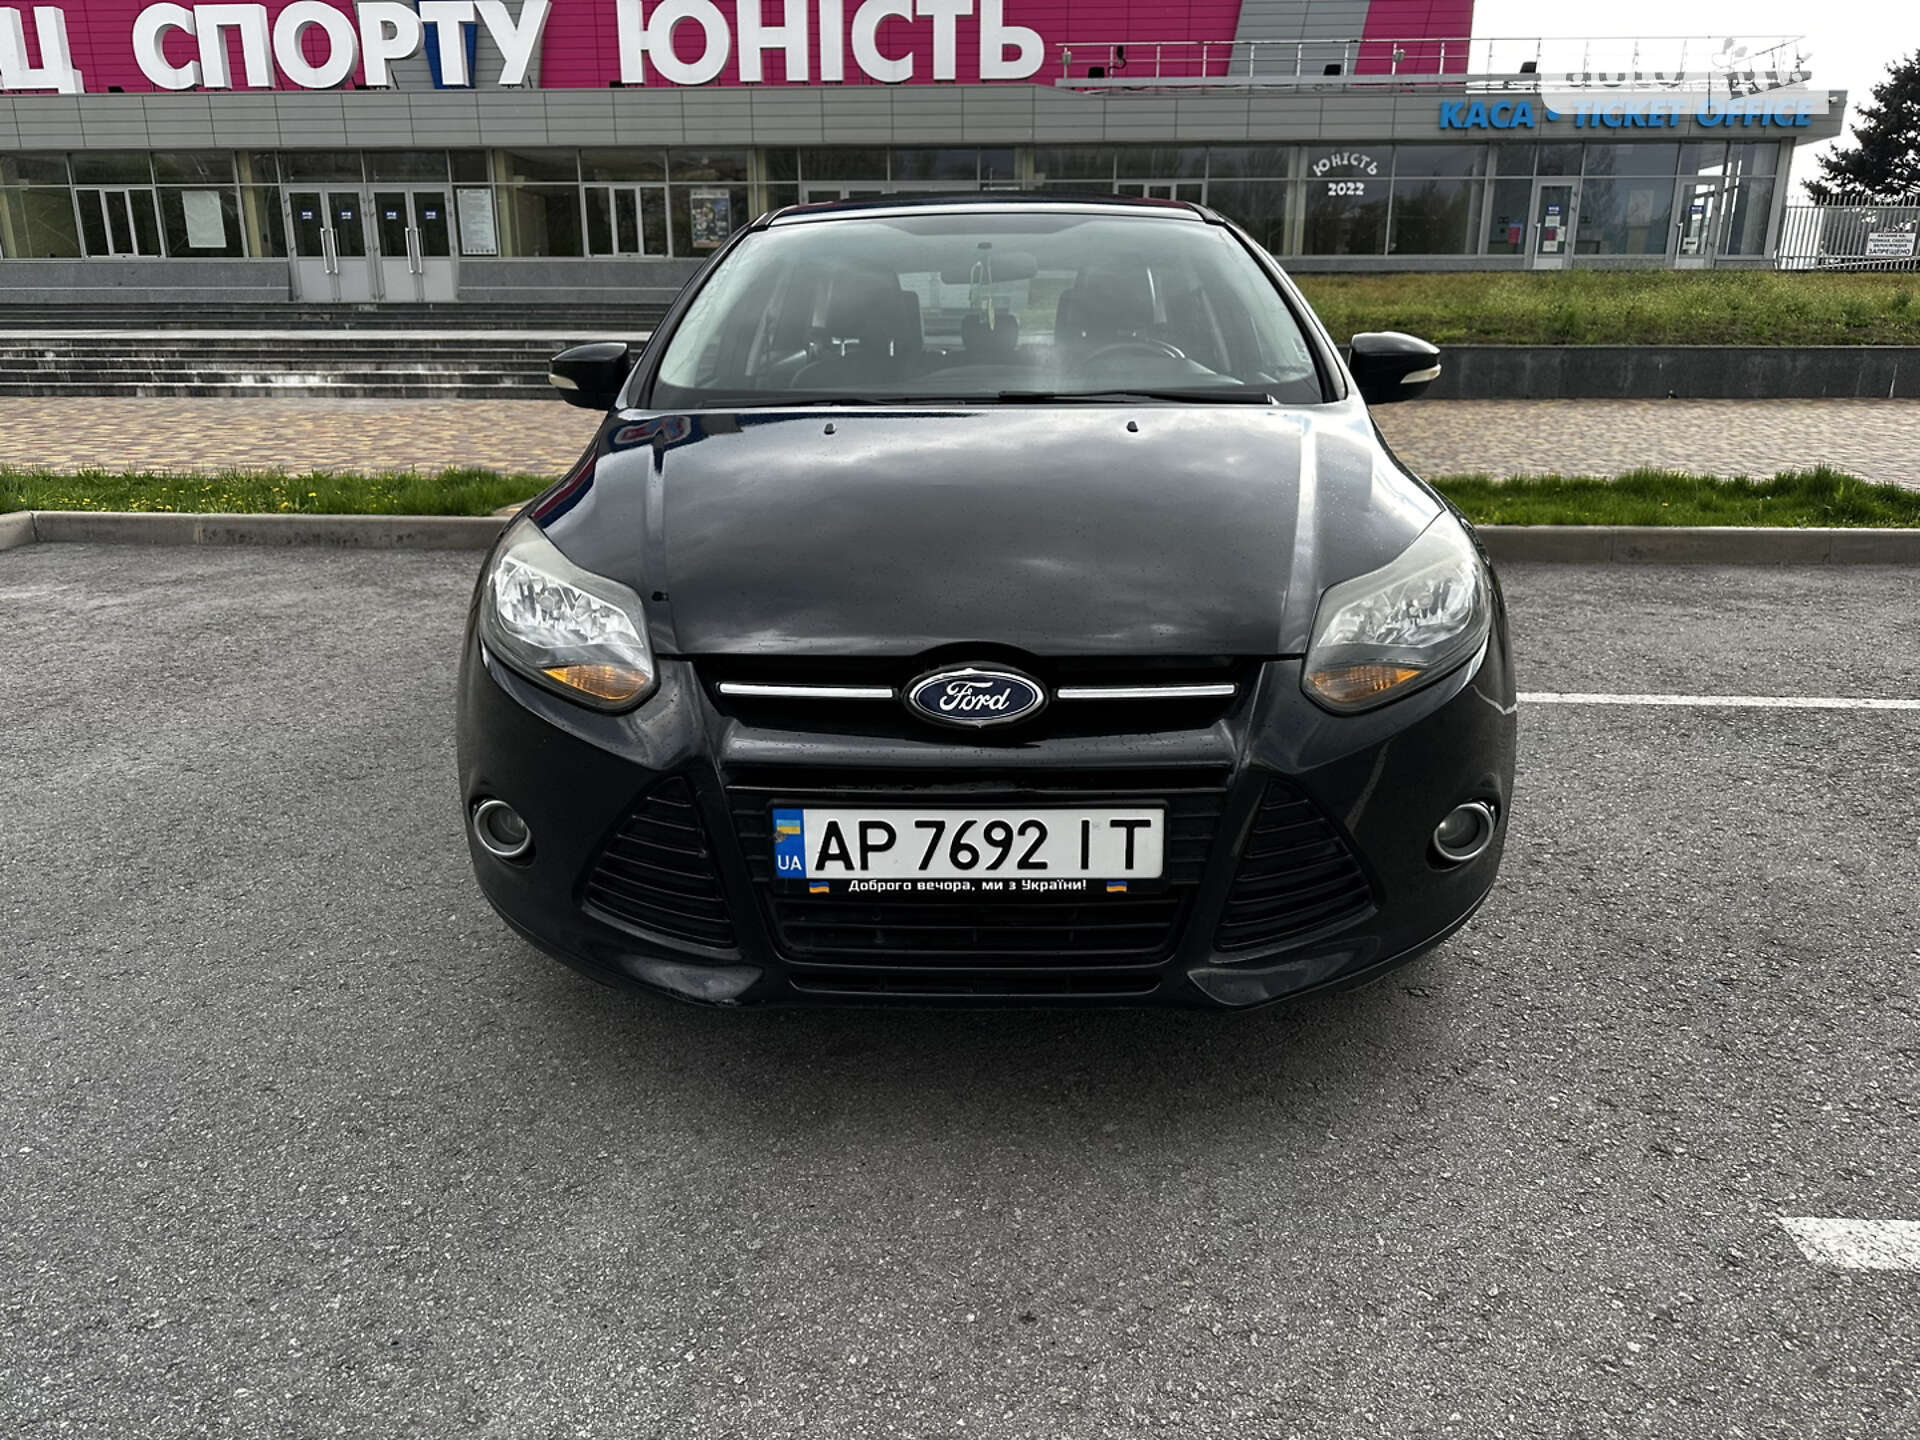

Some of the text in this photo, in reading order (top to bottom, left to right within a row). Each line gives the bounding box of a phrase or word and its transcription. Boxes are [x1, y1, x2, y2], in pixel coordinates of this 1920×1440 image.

[132, 0, 549, 90] СПОРТУ
[617, 0, 1045, 85] ЮНІСТЬ
[1439, 99, 1536, 129] КАСА
[1573, 97, 1814, 129] TICKET OFFICE
[1312, 152, 1377, 176] ЮНІСТЬ
[1327, 182, 1365, 196] 2022
[939, 680, 1010, 712] Ford
[814, 819, 1152, 871] AP 7692 IT
[777, 855, 802, 871] UA
[848, 879, 1087, 893] Доброго вечора, ми з України!
